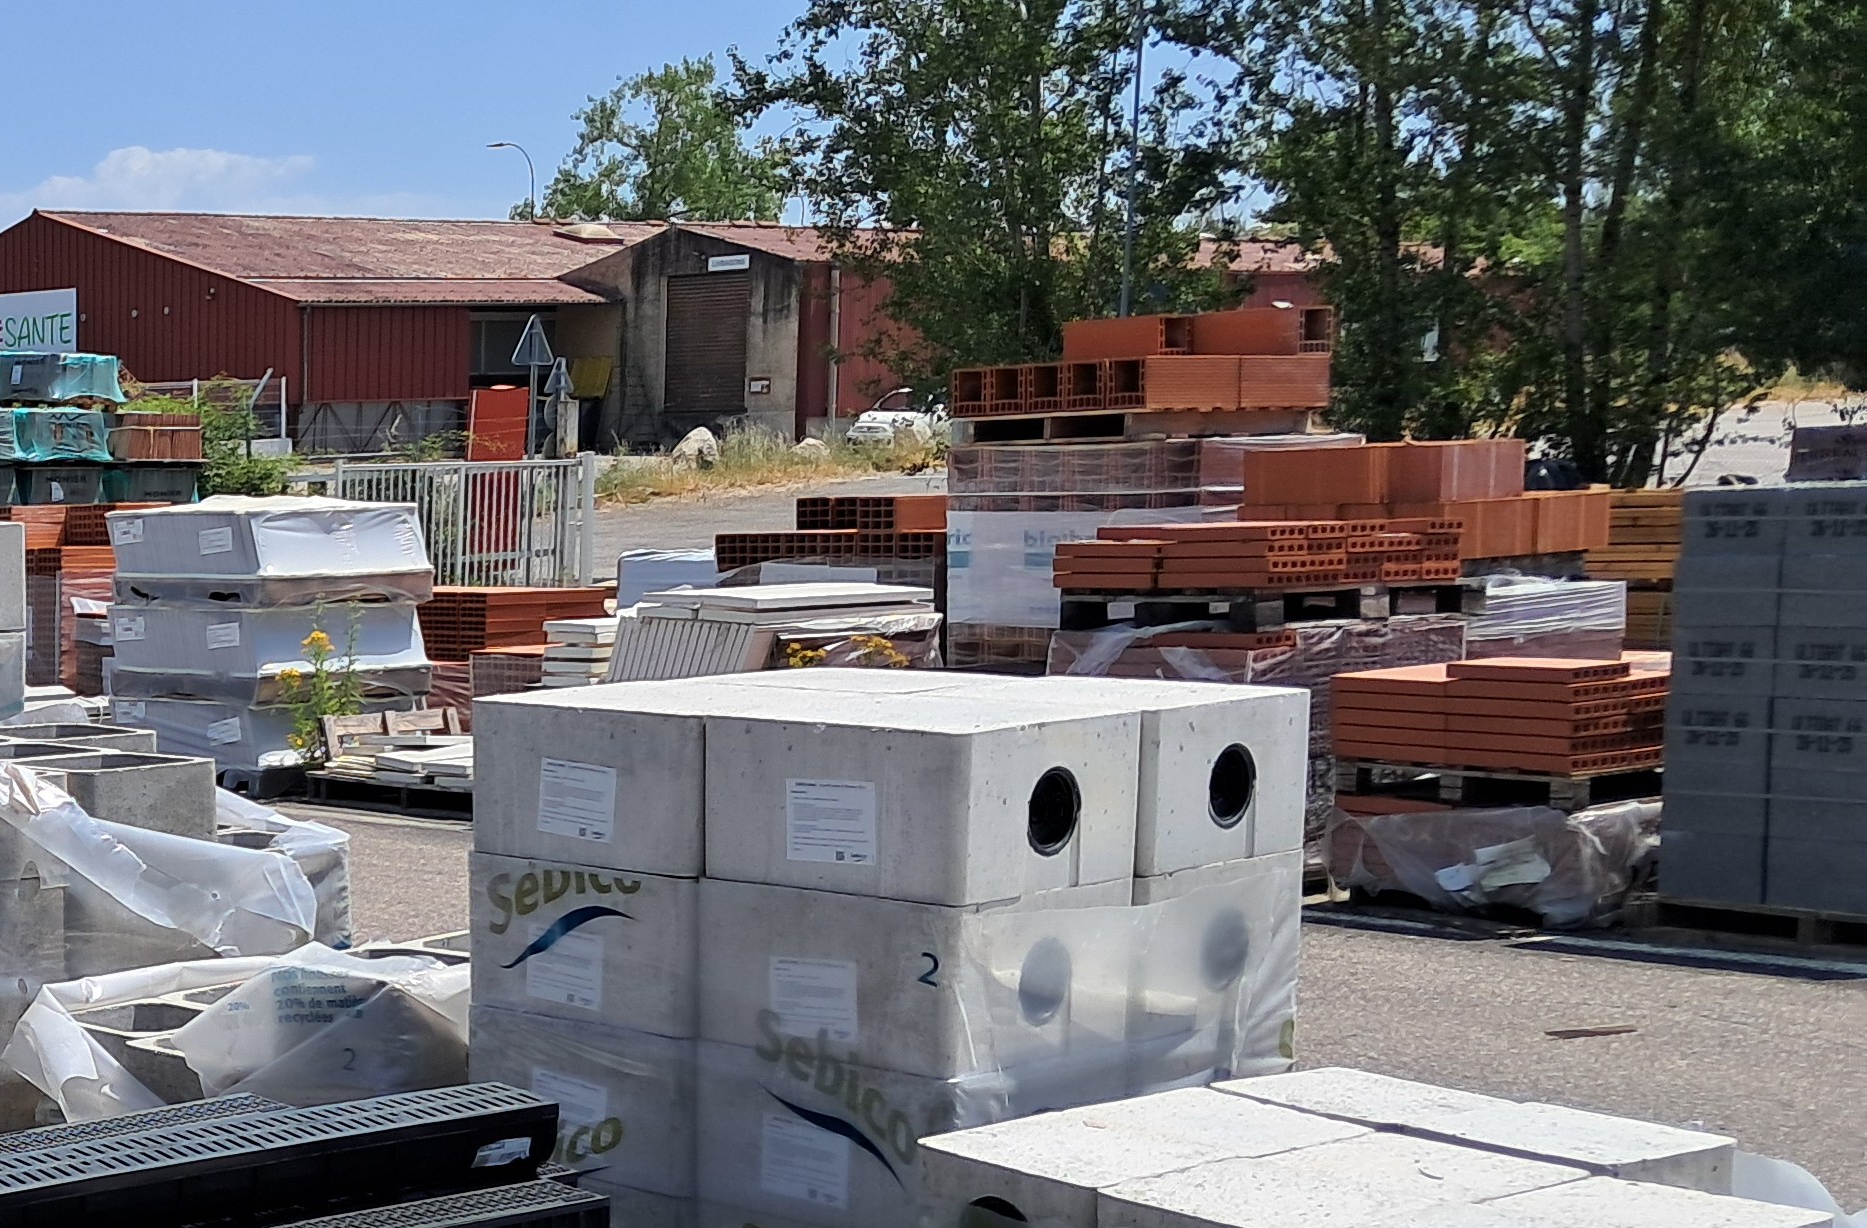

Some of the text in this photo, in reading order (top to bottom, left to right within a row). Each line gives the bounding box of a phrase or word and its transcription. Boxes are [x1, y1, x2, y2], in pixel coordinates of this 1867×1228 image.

[917, 952, 939, 988] 2
[308, 998, 323, 1009] de
[342, 1048, 356, 1071] 2
[755, 1009, 917, 1166] Sebico
